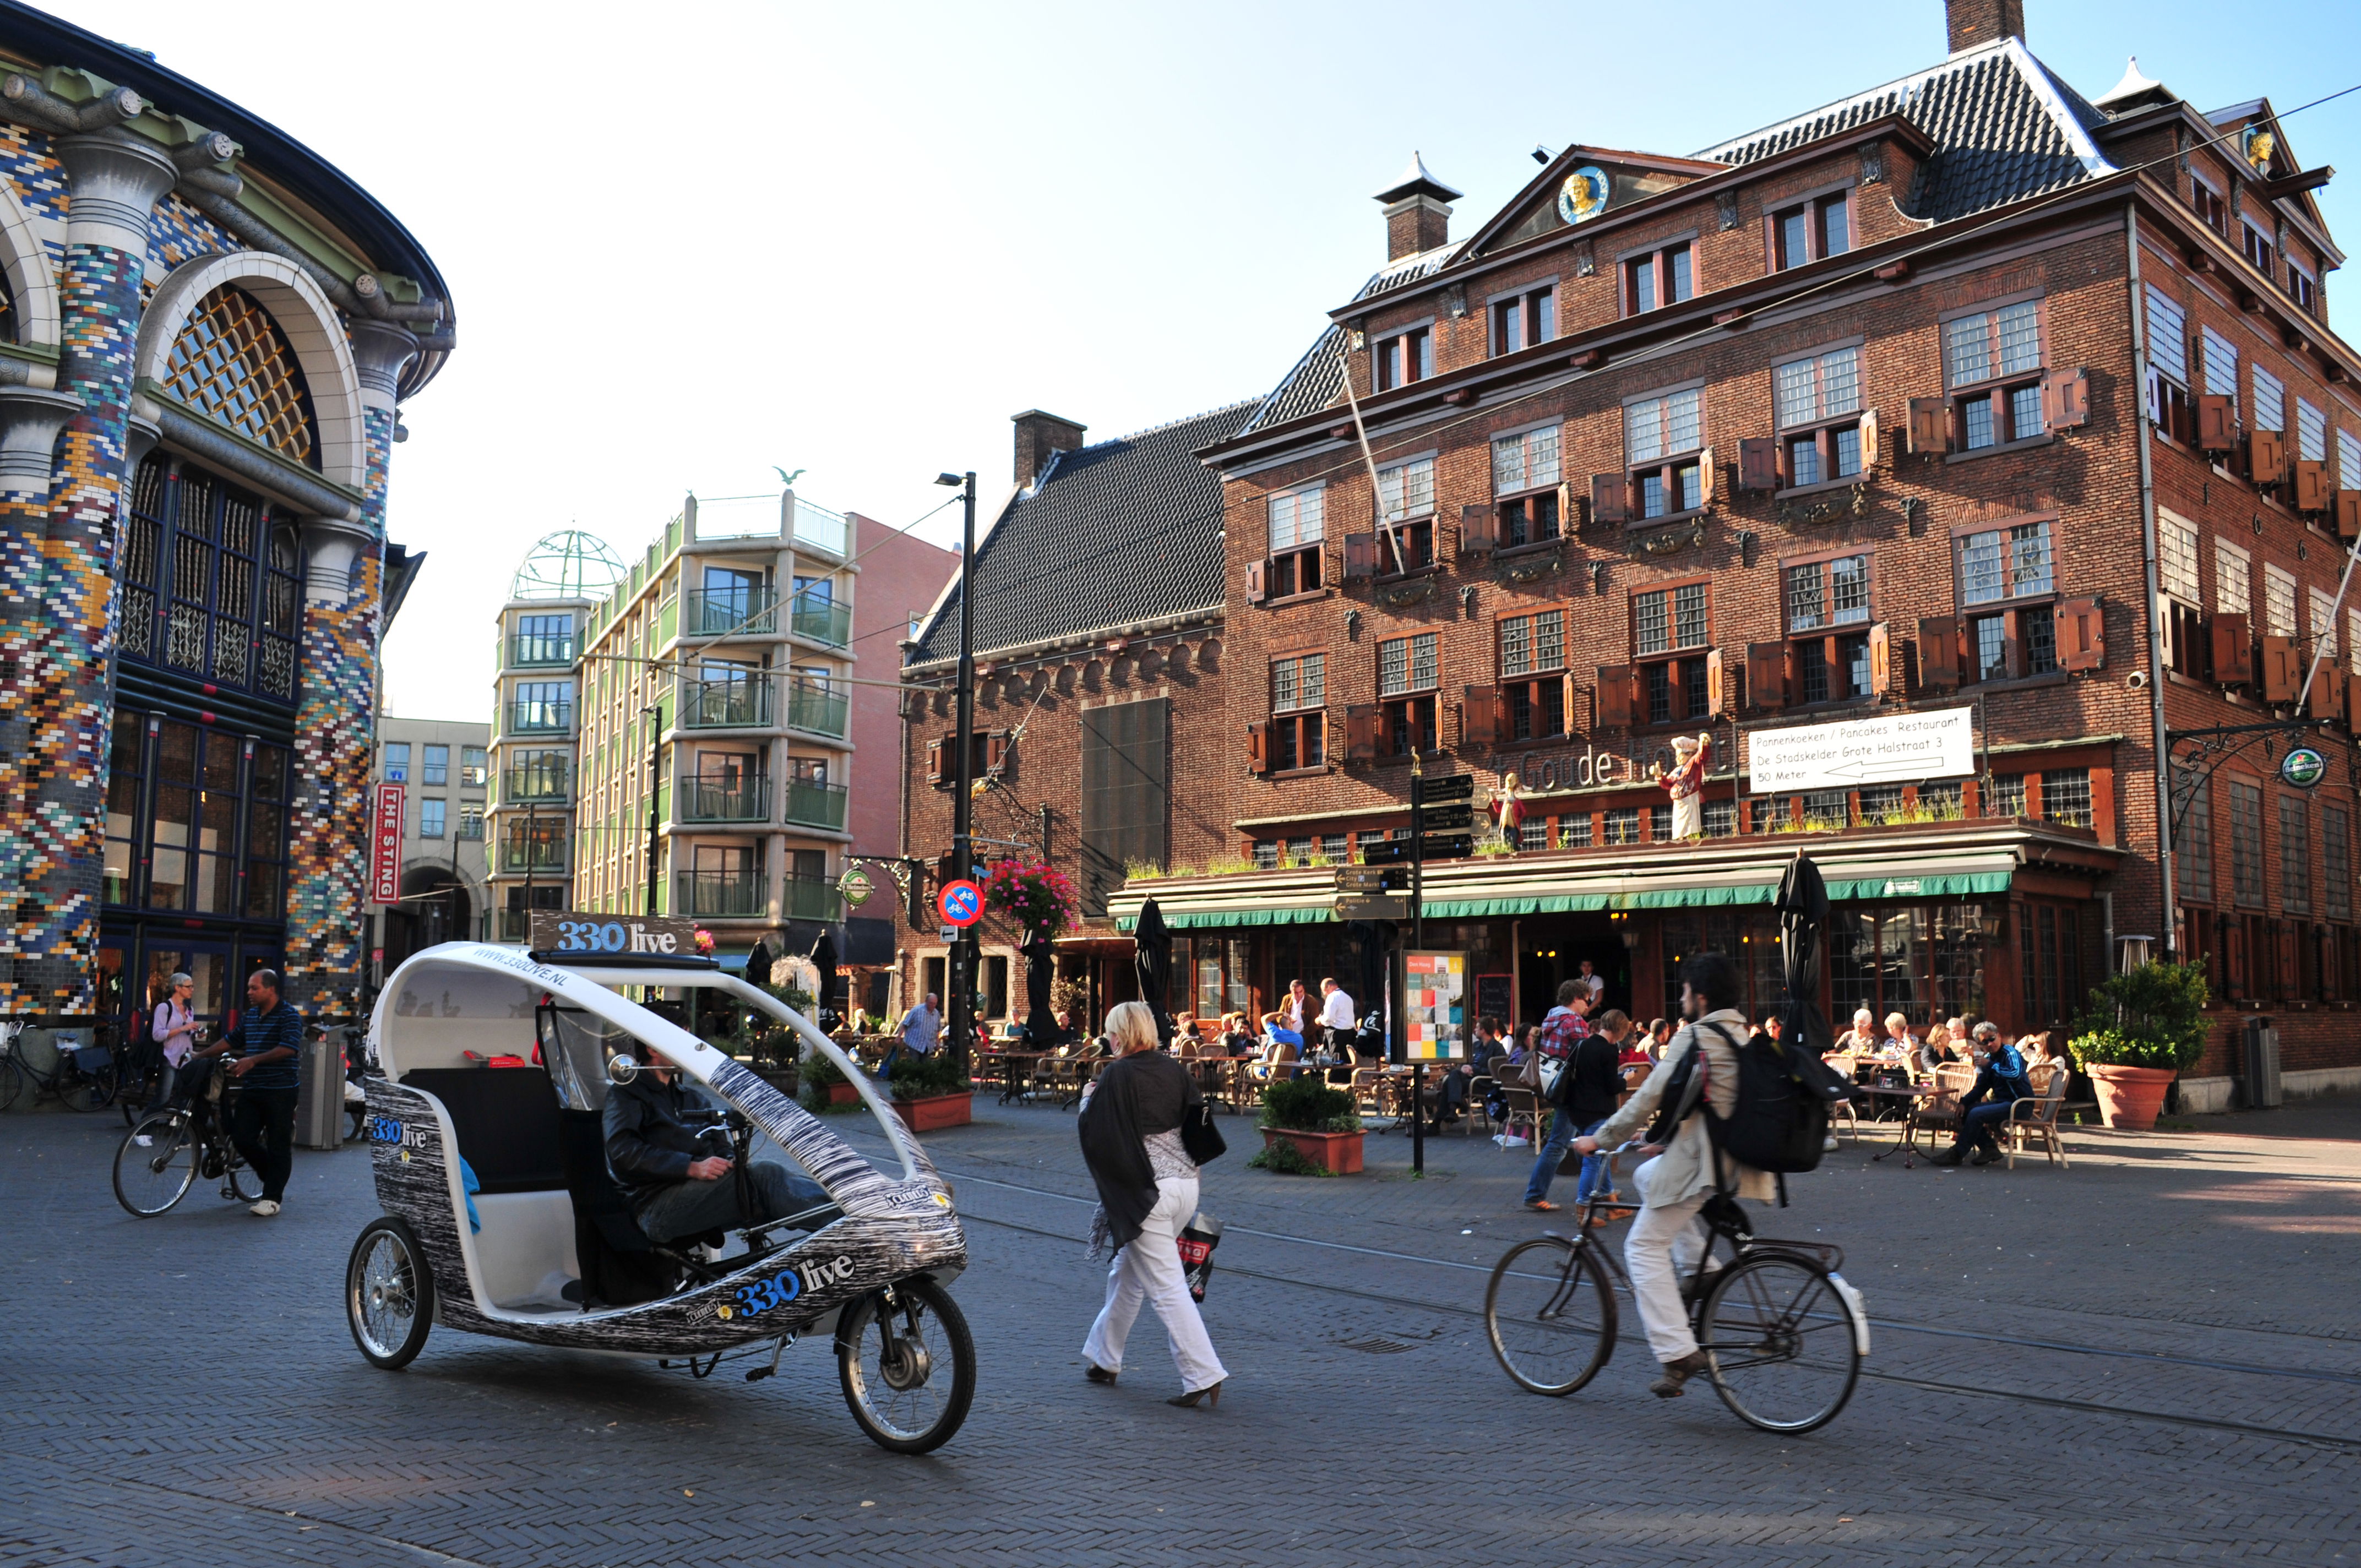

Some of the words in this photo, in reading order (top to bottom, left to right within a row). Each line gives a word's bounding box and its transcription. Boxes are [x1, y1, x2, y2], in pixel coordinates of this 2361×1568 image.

[1756, 732, 1825, 747] Pannenkoeken
[1830, 729, 1835, 739] /
[1840, 725, 1888, 738] Pancakes
[1898, 716, 1959, 732] Restaurant
[1520, 744, 1613, 792] Goude
[1629, 732, 1727, 781] Hot
[1758, 755, 1770, 766] De
[1775, 749, 1837, 764] Stadskelder
[1842, 746, 1872, 757] Grote
[1878, 739, 1930, 754] Halstraat
[1936, 737, 1943, 748] 3
[2284, 763, 2320, 773] Heineken
[1758, 772, 1771, 782] 50
[1776, 771, 1807, 781] Meter
[384, 792, 397, 829] THE
[380, 835, 395, 896] STING
[557, 921, 625, 952] 330
[630, 923, 677, 954] live
[472, 946, 568, 987] WWW.330LIVE.NL
[373, 1117, 401, 1144] 330
[402, 1121, 427, 1148] live
[735, 1268, 800, 1317] 330
[798, 1255, 855, 1293] live
